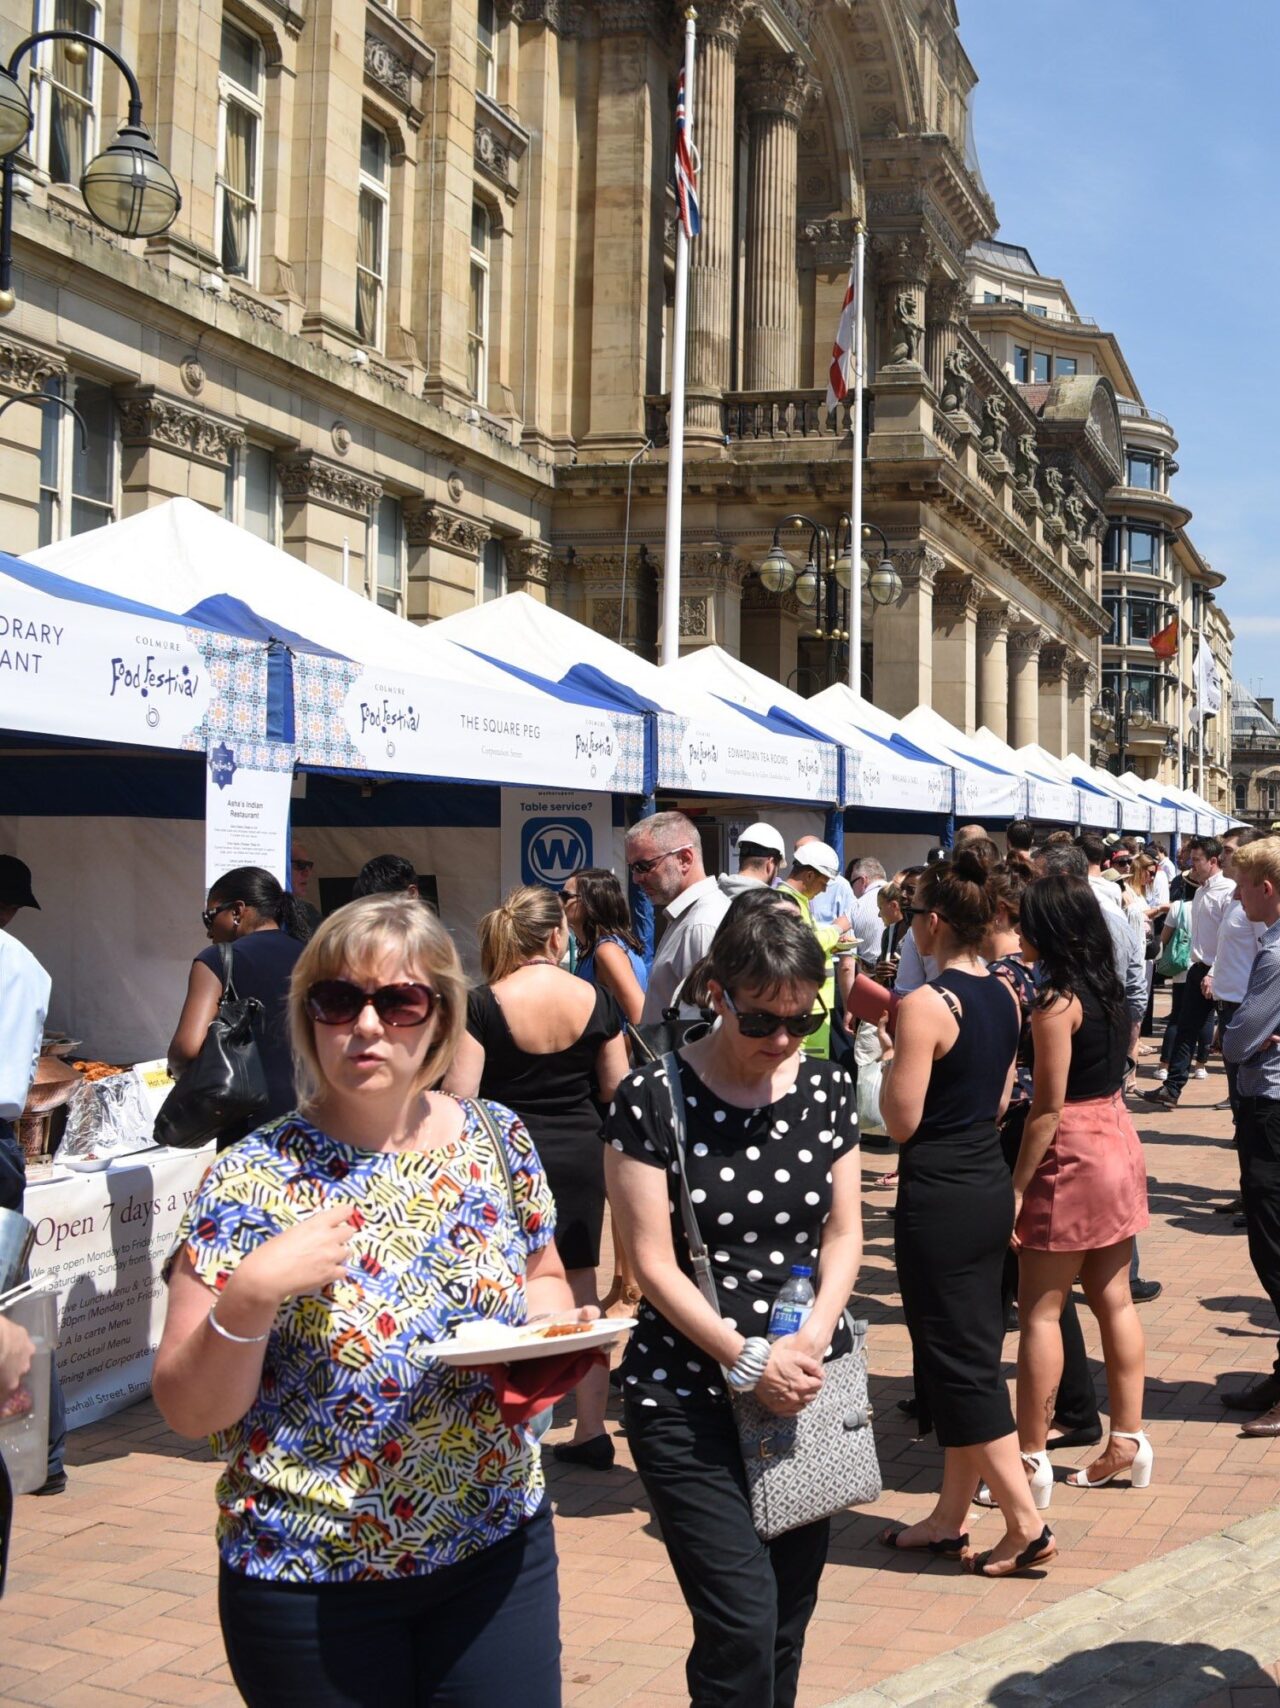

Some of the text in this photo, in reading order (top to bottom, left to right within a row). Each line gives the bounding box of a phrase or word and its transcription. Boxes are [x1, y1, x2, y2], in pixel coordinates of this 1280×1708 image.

[135, 635, 180, 652] COLMORE
[110, 656, 199, 698] Food Festival
[360, 700, 420, 734] Food Festival
[460, 714, 541, 739] THE SQUARE PEG
[520, 802, 592, 811] Table service?
[532, 839, 580, 870] W
[35, 1216, 94, 1250] Open
[102, 1203, 115, 1231] 7
[120, 1195, 161, 1226] days
[167, 1194, 177, 1212] a
[46, 1264, 61, 1275] are
[62, 1258, 85, 1271] open
[87, 1247, 119, 1263] Monday
[132, 1238, 154, 1251] Friday
[156, 1231, 173, 1243] from
[86, 1269, 97, 1278] to
[99, 1260, 127, 1275] Sunday
[129, 1255, 148, 1266] from
[149, 1249, 165, 1262] 5pm.
[80, 1293, 105, 1309] Lunch
[107, 1286, 130, 1300] Menu
[132, 1280, 138, 1291] &
[88, 1299, 125, 1321] (Monday
[126, 1296, 135, 1306] to
[138, 1286, 164, 1302] Friday)
[64, 1336, 72, 1345] A
[74, 1332, 82, 1343] la
[84, 1325, 106, 1339] carte
[108, 1317, 132, 1331] Menu
[775, 1311, 799, 1323] STILL
[70, 1345, 106, 1364] Cocktail
[107, 1336, 131, 1350] Menu
[86, 1363, 103, 1375] and
[105, 1349, 150, 1368] Corporate
[64, 1397, 95, 1415] ewhall
[96, 1387, 126, 1404] Street,
